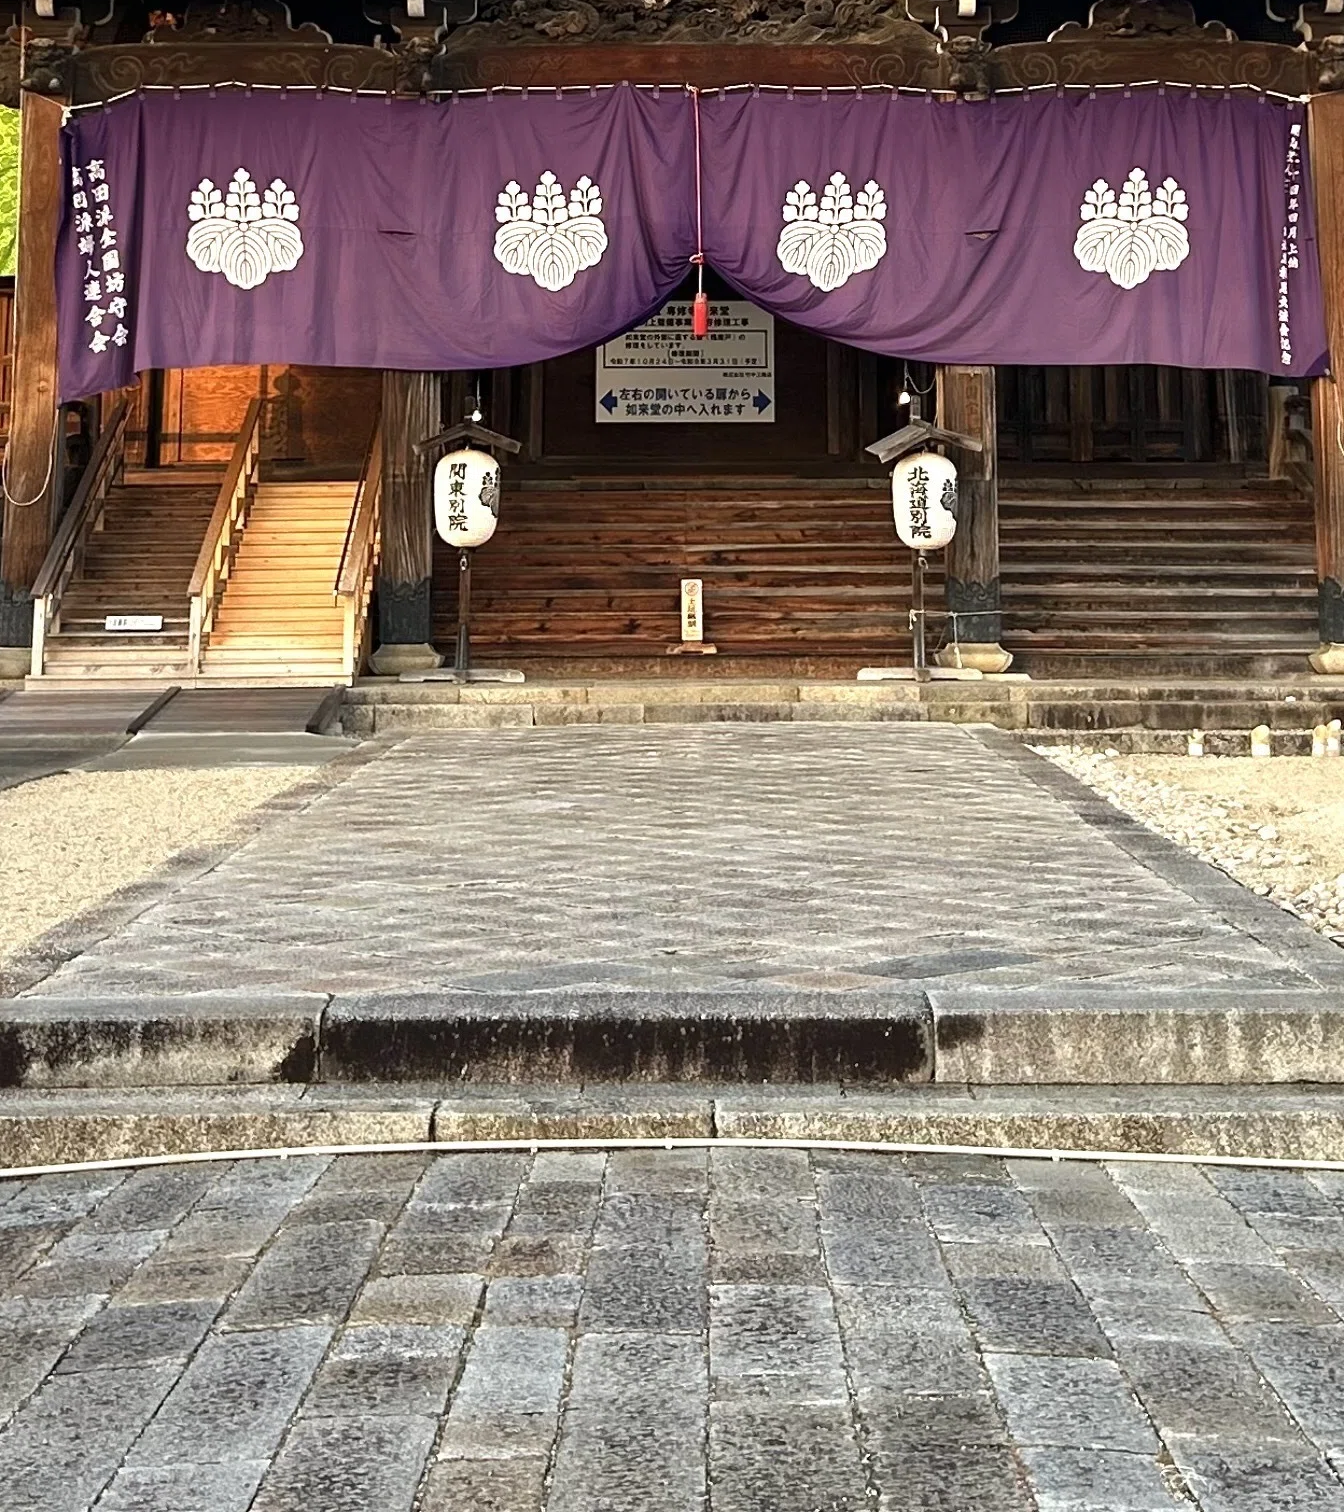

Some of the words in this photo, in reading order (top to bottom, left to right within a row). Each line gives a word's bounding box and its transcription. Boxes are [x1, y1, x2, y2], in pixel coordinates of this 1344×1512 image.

[619, 388, 751, 401] 左右の開いている扉から
[625, 403, 746, 416] 如来堂の中へ入れます
[448, 463, 469, 532] 関東別院
[907, 466, 932, 539] 北海道別院
